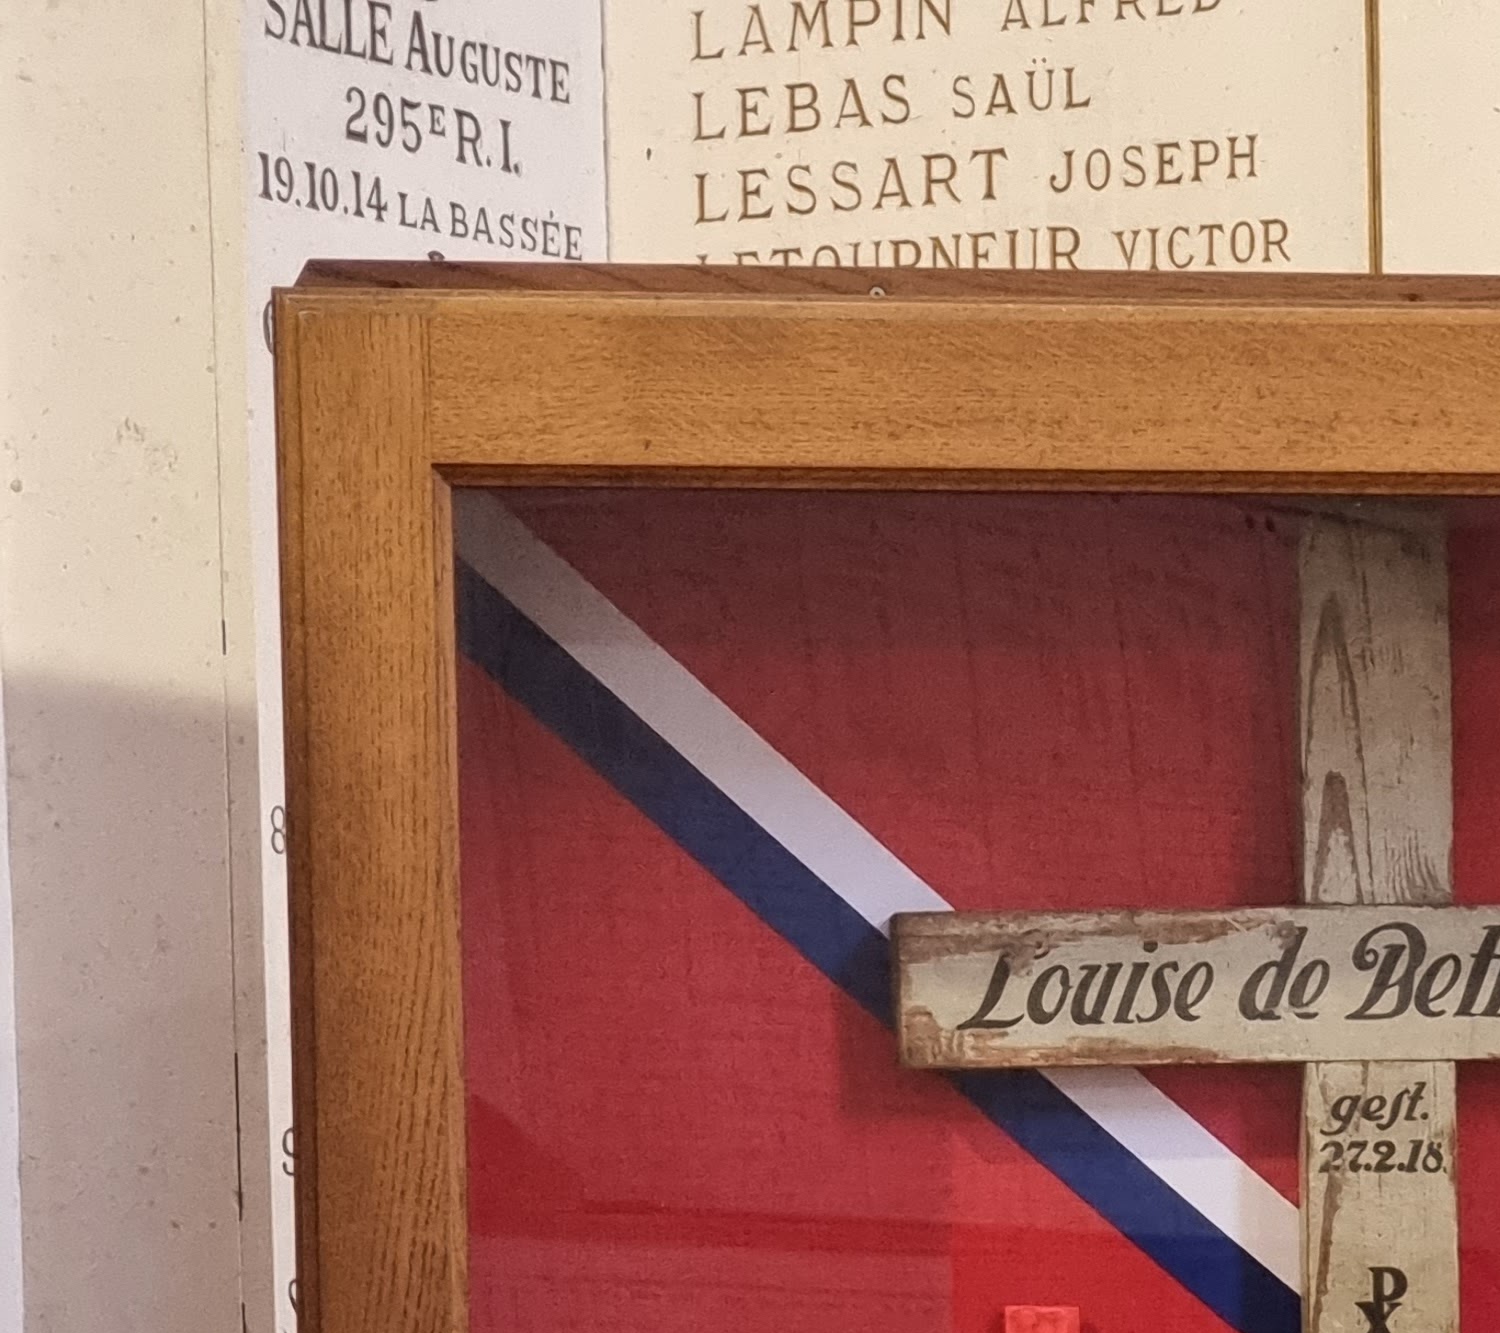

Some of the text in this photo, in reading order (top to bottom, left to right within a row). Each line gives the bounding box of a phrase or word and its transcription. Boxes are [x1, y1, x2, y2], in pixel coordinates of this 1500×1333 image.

[264, 0, 394, 65] SALLE
[690, 0, 952, 61] LAMPIN
[693, 57, 1092, 141] LEBAS SAÜL
[257, 151, 388, 222] 19.10.14
[397, 191, 442, 234] LA
[694, 134, 1258, 225] LESSART JOSEPH
[1112, 218, 1291, 271] VICTOR
[956, 940, 1214, 1031] Louise
[1238, 925, 1331, 1021] de
